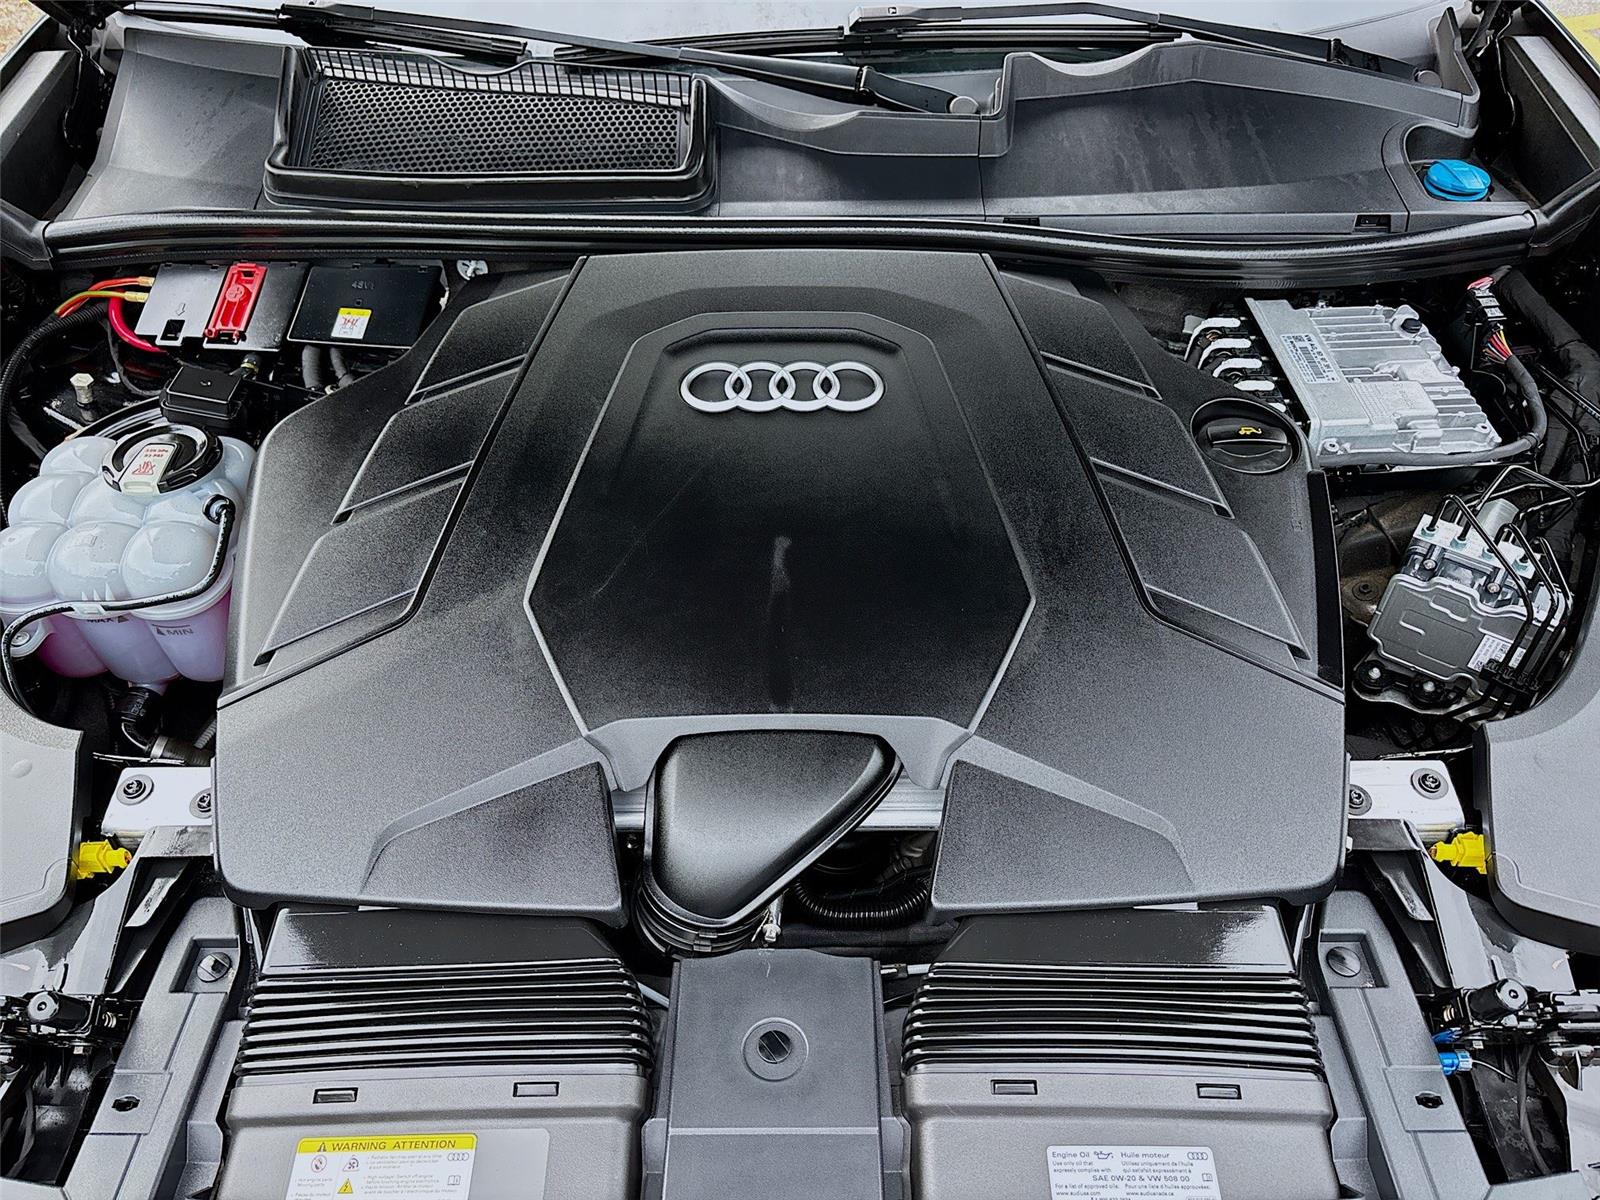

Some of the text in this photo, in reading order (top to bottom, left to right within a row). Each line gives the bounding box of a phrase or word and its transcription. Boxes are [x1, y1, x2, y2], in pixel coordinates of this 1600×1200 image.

[166, 627, 194, 636] MIN
[331, 1139, 456, 1151] WARNING ATTENTION
[1092, 1174, 1109, 1182] SAE
